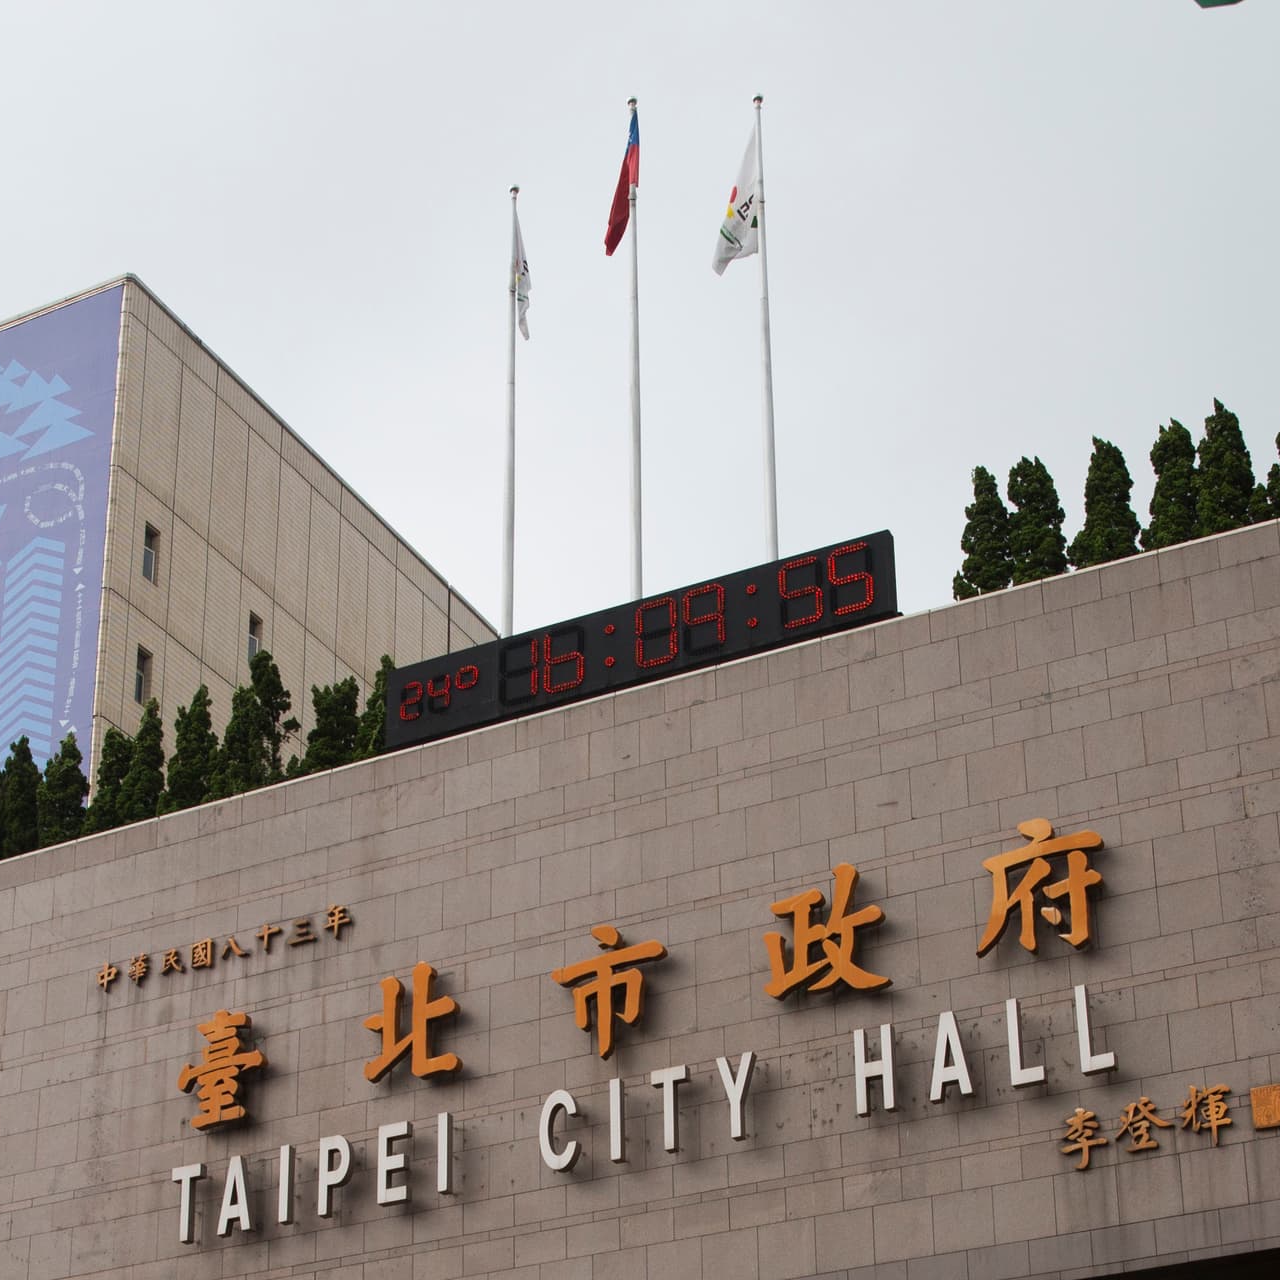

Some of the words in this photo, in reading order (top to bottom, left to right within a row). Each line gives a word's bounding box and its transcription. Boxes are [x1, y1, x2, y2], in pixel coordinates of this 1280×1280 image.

[529, 541, 876, 696] 16:09:55
[95, 903, 353, 992] 中華民國八十三年
[177, 816, 1107, 1132] 臺北市政府
[171, 1111, 453, 1245] TAIPEI
[539, 1051, 757, 1173] CITY
[853, 984, 1118, 1118] HALL
[1060, 1083, 1234, 1171] 李登輝
